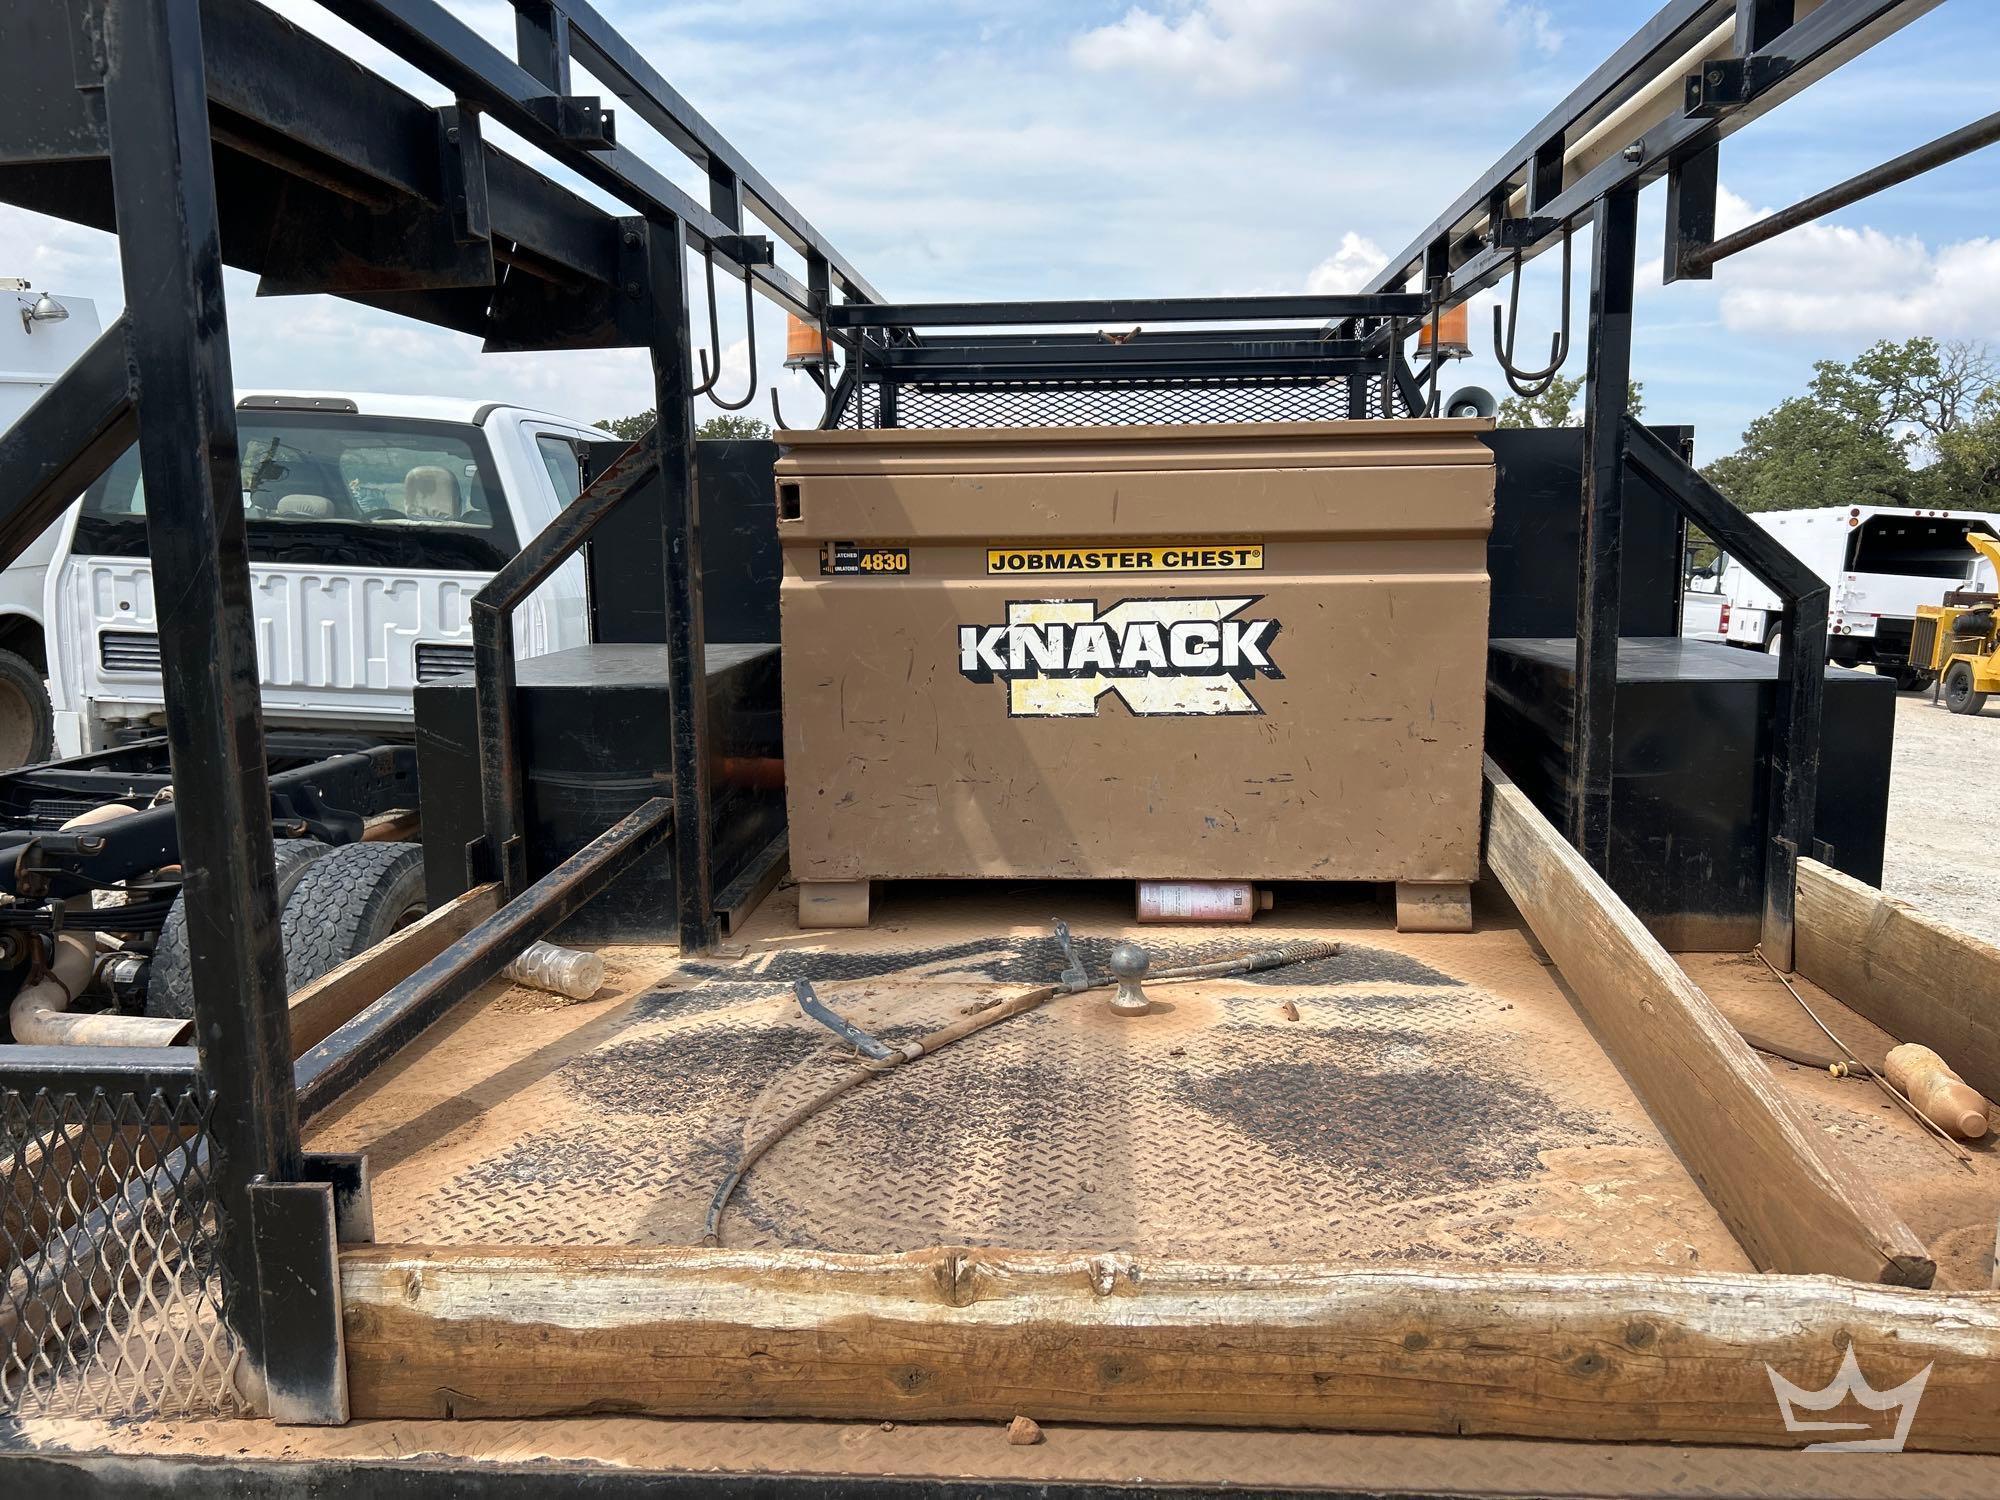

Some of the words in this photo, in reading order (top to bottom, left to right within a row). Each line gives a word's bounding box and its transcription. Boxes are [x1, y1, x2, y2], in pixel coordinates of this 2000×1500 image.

[860, 554, 906, 570] 4830
[991, 552, 1153, 571] JOBMASTER
[959, 619, 1279, 677] KNAACK
